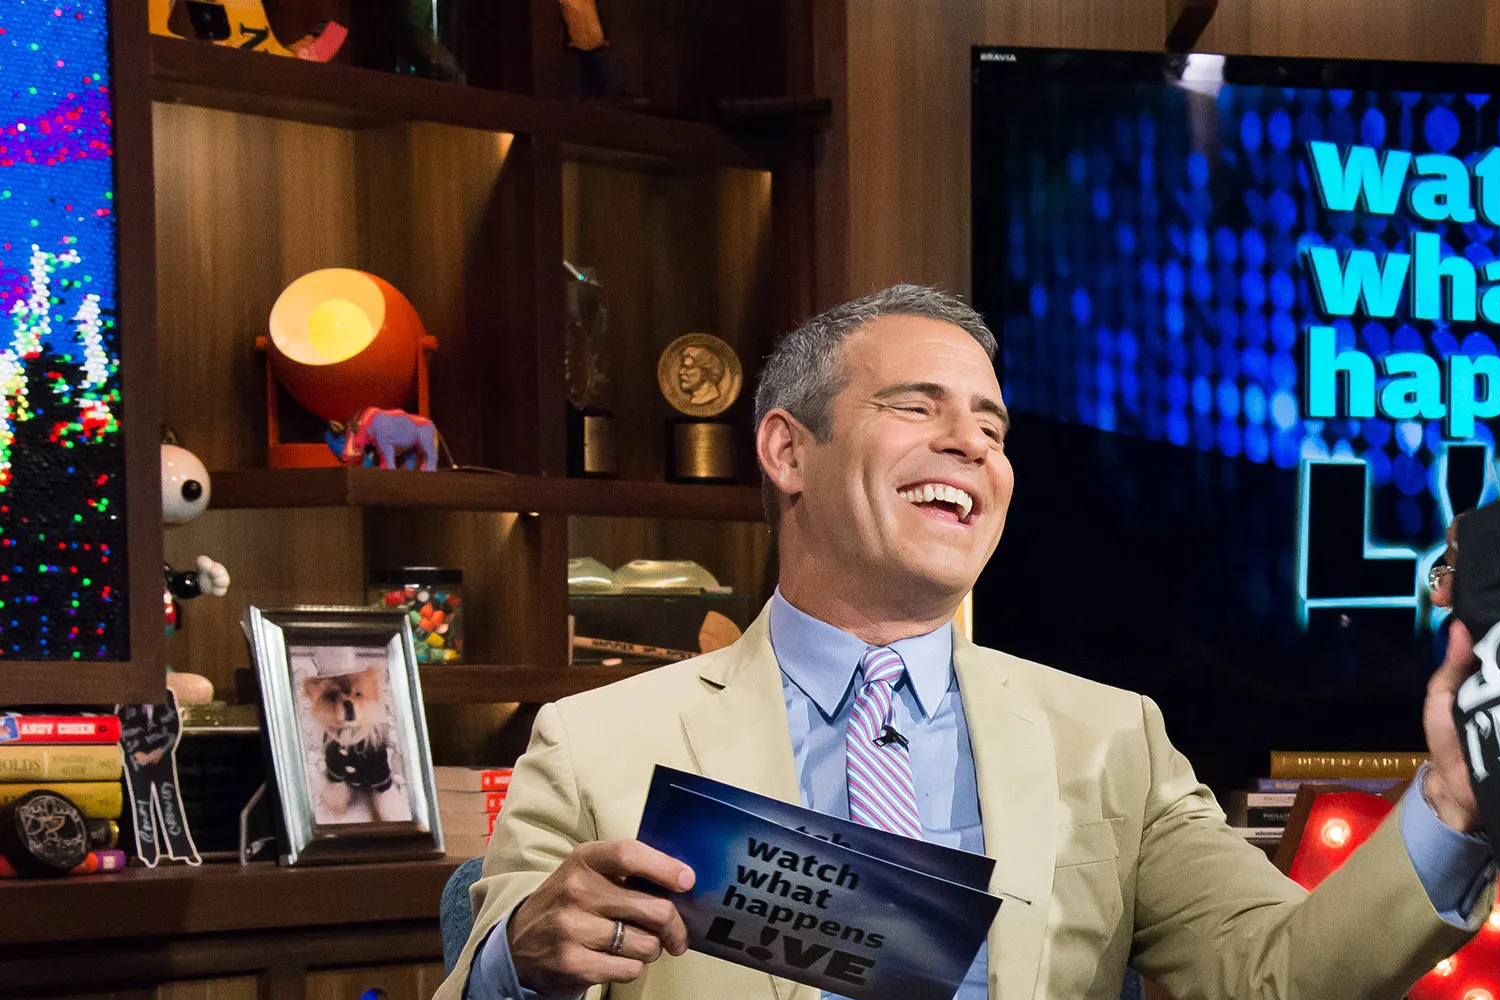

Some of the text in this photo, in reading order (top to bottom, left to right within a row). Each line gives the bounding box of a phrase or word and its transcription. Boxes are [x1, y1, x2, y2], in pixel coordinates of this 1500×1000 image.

[980, 53, 1017, 62] BRAVIA
[735, 865, 833, 911] what
[746, 837, 860, 891] watch
[721, 884, 886, 950] happens
